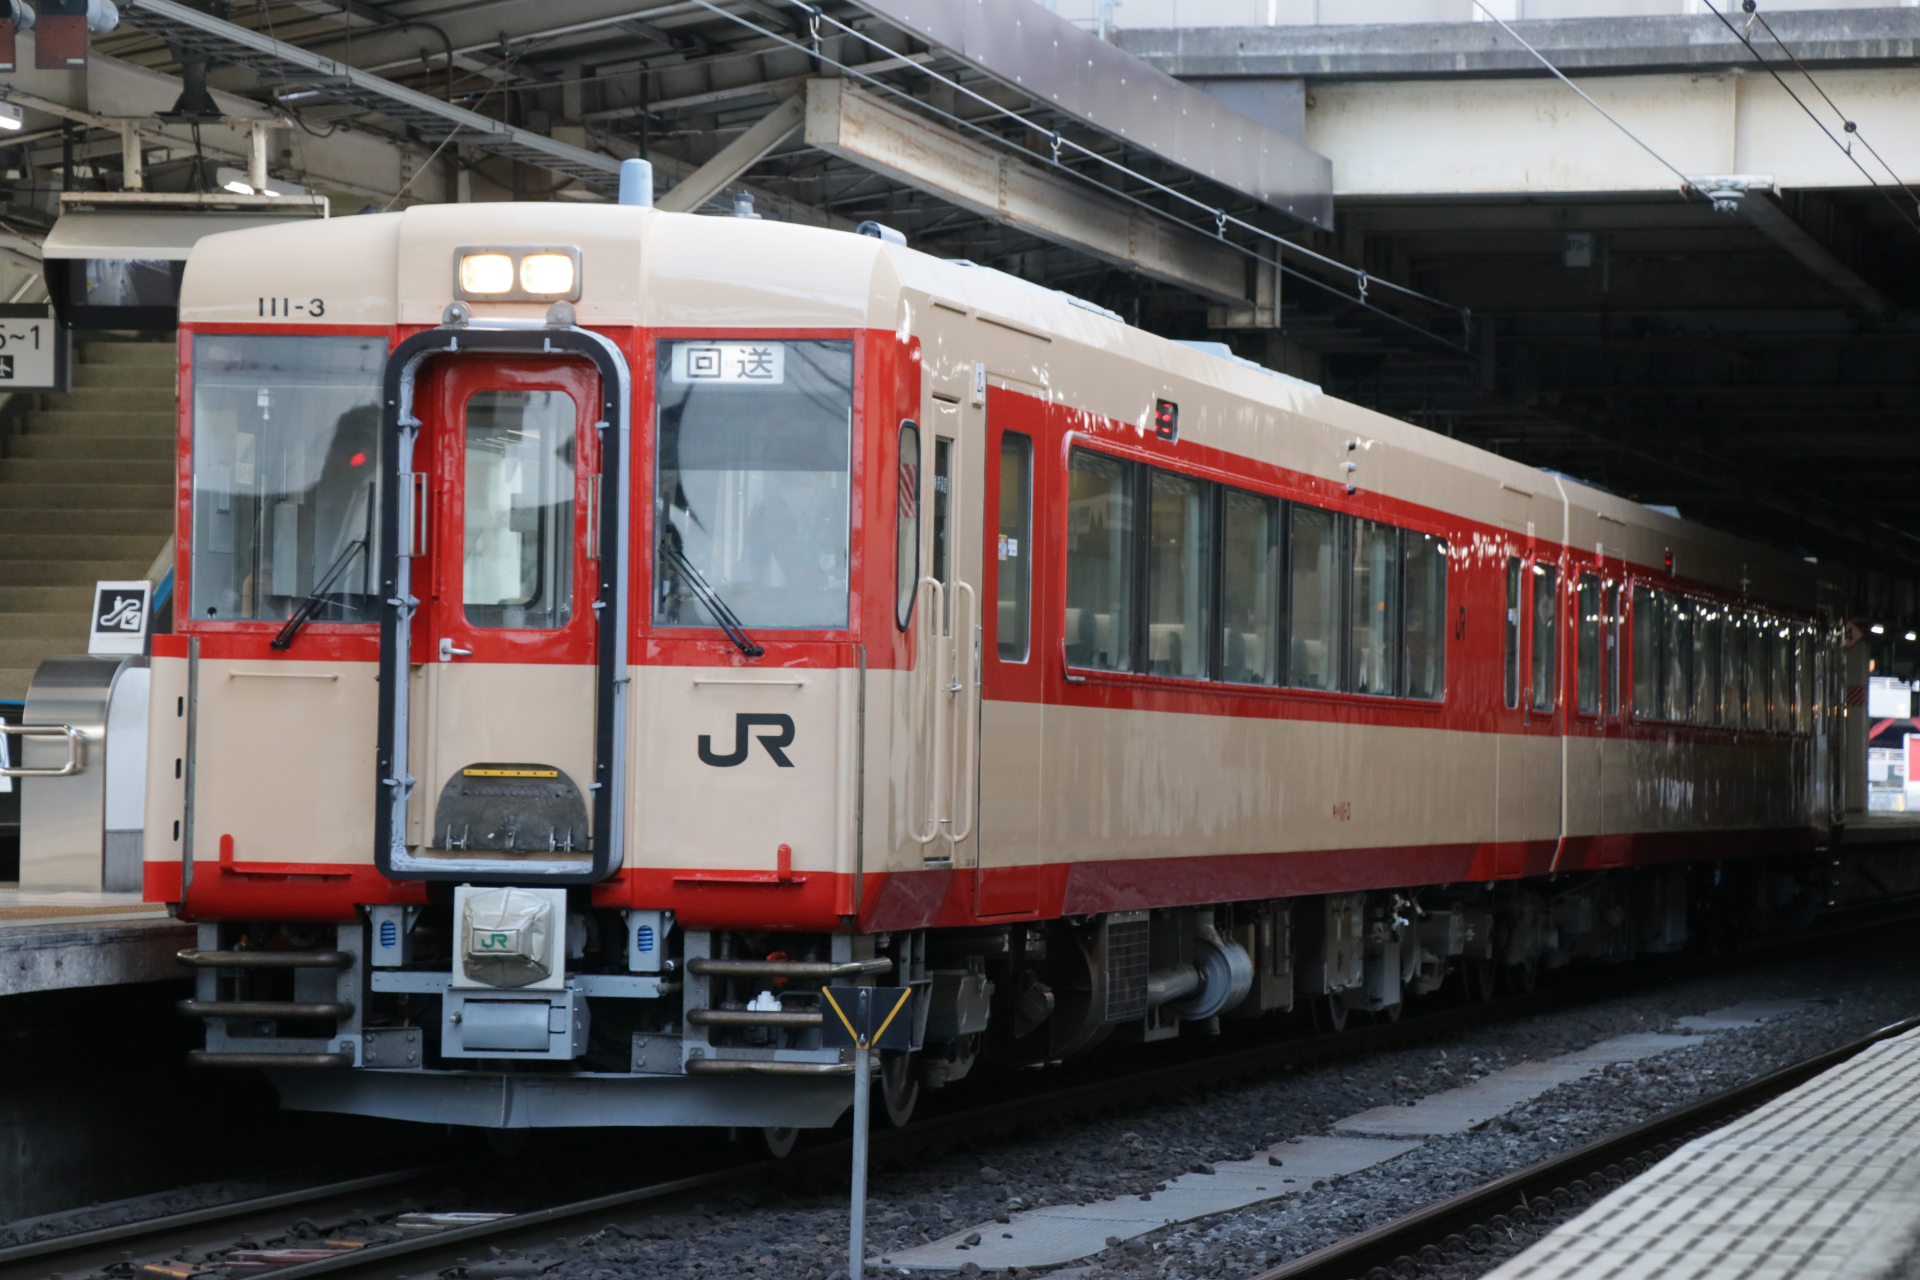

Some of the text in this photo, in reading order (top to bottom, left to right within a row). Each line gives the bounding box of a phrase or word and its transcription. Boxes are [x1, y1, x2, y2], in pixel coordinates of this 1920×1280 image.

[686, 346, 773, 379] 回送
[1455, 605, 1466, 642] JR
[698, 713, 795, 767] JR
[481, 933, 508, 949] JR
